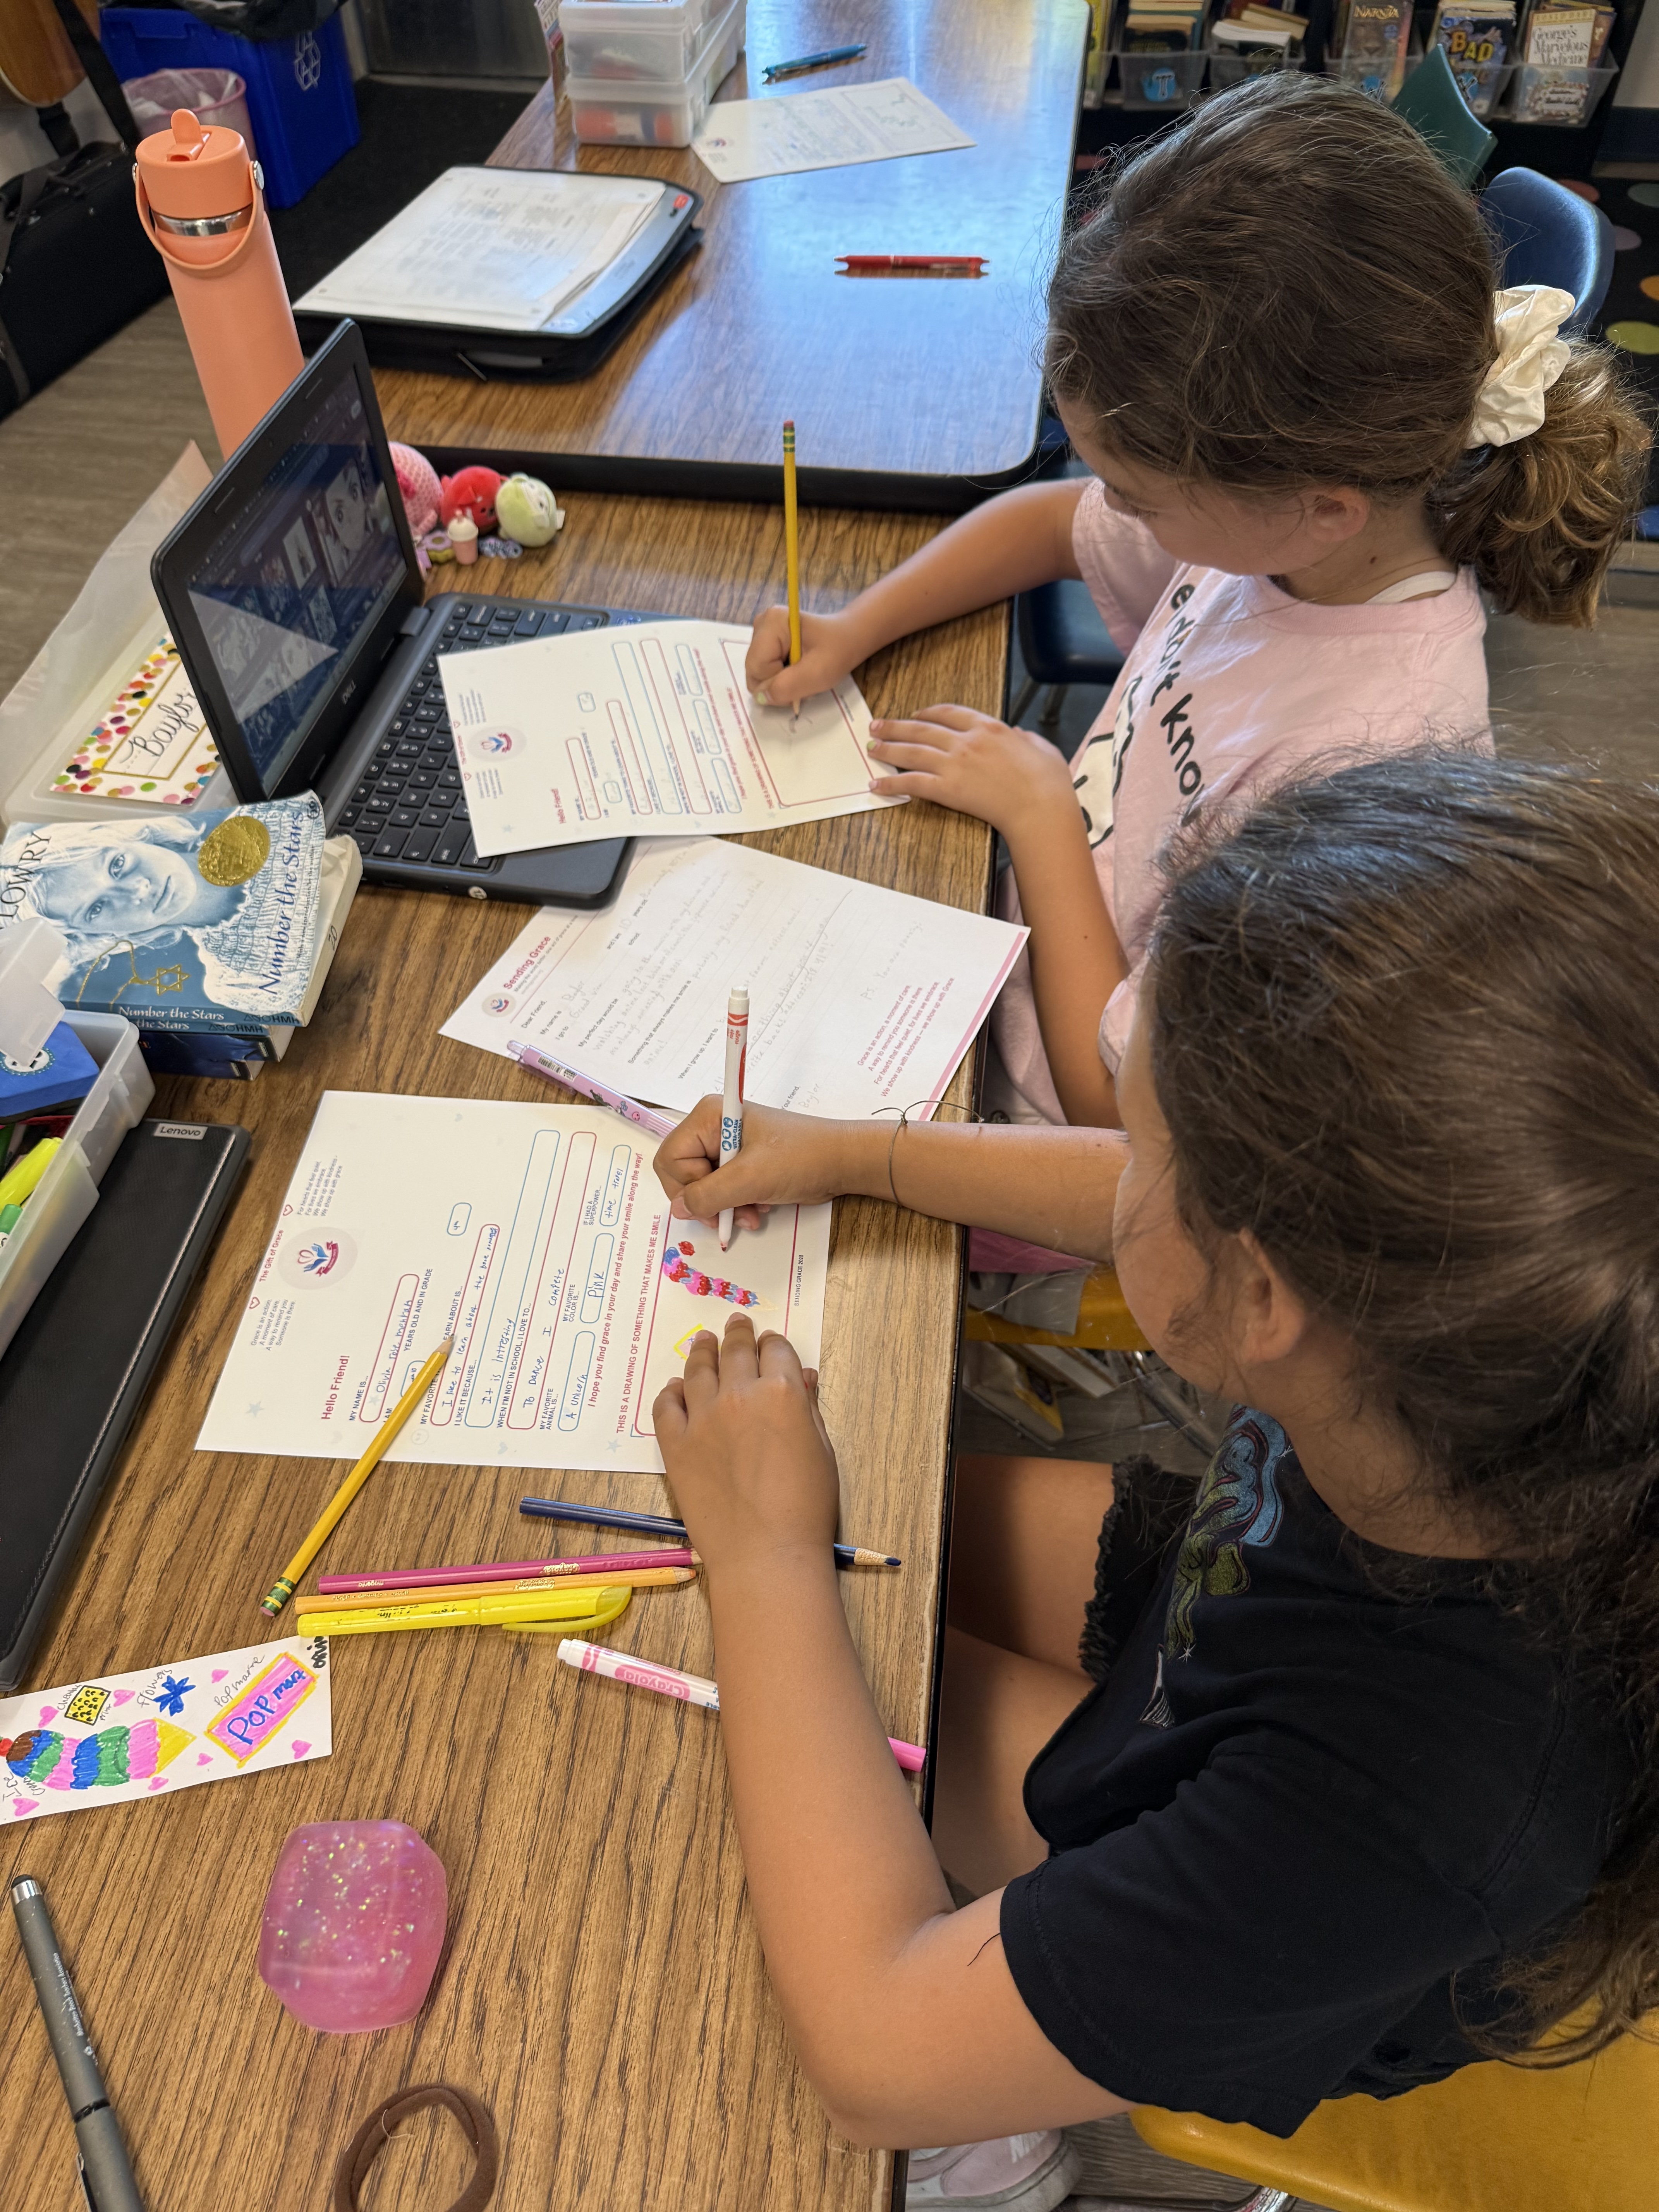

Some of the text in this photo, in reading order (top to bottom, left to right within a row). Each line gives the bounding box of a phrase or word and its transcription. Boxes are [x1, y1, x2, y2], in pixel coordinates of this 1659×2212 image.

[1354, 5, 1399, 19] NARNIA
[1451, 31, 1494, 62] BAD
[0, 833, 52, 917] LOWRY
[259, 812, 304, 994] Number the Stars
[503, 936, 551, 989] Sending Grace
[118, 1006, 224, 1020] Number the Stars
[272, 1014, 299, 1024] HMH
[157, 1020, 189, 1030] Stars
[238, 1024, 263, 1033] HMH
[871, 1056, 882, 1067] way
[891, 1025, 900, 1036] you
[160, 1126, 201, 1138] Lenovo
[634, 1152, 644, 1169] way!
[631, 1170, 640, 1181] the
[627, 1182, 639, 1202] along
[624, 1202, 634, 1222] smile
[621, 1222, 630, 1240] your
[651, 1214, 661, 1236] SMILE
[616, 1240, 627, 1261] share
[648, 1237, 658, 1247] ME
[259, 1269, 269, 1282] The
[264, 1257, 275, 1269] Gift
[271, 1230, 284, 1248] Grace
[644, 1249, 655, 1274] MAKES
[421, 1268, 433, 1290] GRADE
[614, 1262, 622, 1277] and
[473, 1274, 485, 1290] the
[610, 1278, 621, 1292] day
[640, 1275, 651, 1295] THAT
[414, 1298, 424, 1313] AND
[522, 1303, 531, 1317] TO...
[562, 1284, 576, 1322] MY FAVORITE
[568, 1302, 577, 1322] COLOR
[607, 1293, 617, 1312] your
[410, 1314, 420, 1328] OLD
[443, 1322, 453, 1339] EARN
[448, 1298, 460, 1321] ABOUT
[518, 1318, 528, 1336] LOVE
[604, 1313, 613, 1321] in
[632, 1297, 647, 1342] SOMETHING
[403, 1329, 416, 1352] YEARS
[601, 1322, 611, 1345] grace
[456, 1336, 469, 1355] learn
[510, 1341, 524, 1370] SCHOOL,
[596, 1345, 607, 1362] find
[630, 1343, 639, 1355] OF
[451, 1365, 464, 1379] to
[490, 1374, 503, 1386] is
[594, 1363, 603, 1380] you
[623, 1356, 637, 1395] DRAWING
[320, 1355, 350, 1420] Hello Friend!
[455, 1406, 465, 1422] LIKE
[461, 1359, 477, 1397] BECAUSE...
[481, 1385, 501, 1407] It
[504, 1380, 514, 1395] NOT
[588, 1381, 601, 1403] hope
[349, 1376, 369, 1421] MY NAME IS...
[420, 1377, 438, 1424] MY FAVORITE
[441, 1397, 456, 1408] I
[501, 1396, 510, 1405] I'M
[496, 1407, 508, 1428] WHEN
[539, 1388, 554, 1430] MY FAVORITE
[545, 1406, 556, 1431] ANIMAL
[565, 1412, 577, 1420] A
[620, 1405, 629, 1413] IS
[616, 1414, 627, 1434] THIS
[358, 1580, 385, 1589] magenta
[624, 1670, 685, 1697] Crayola
